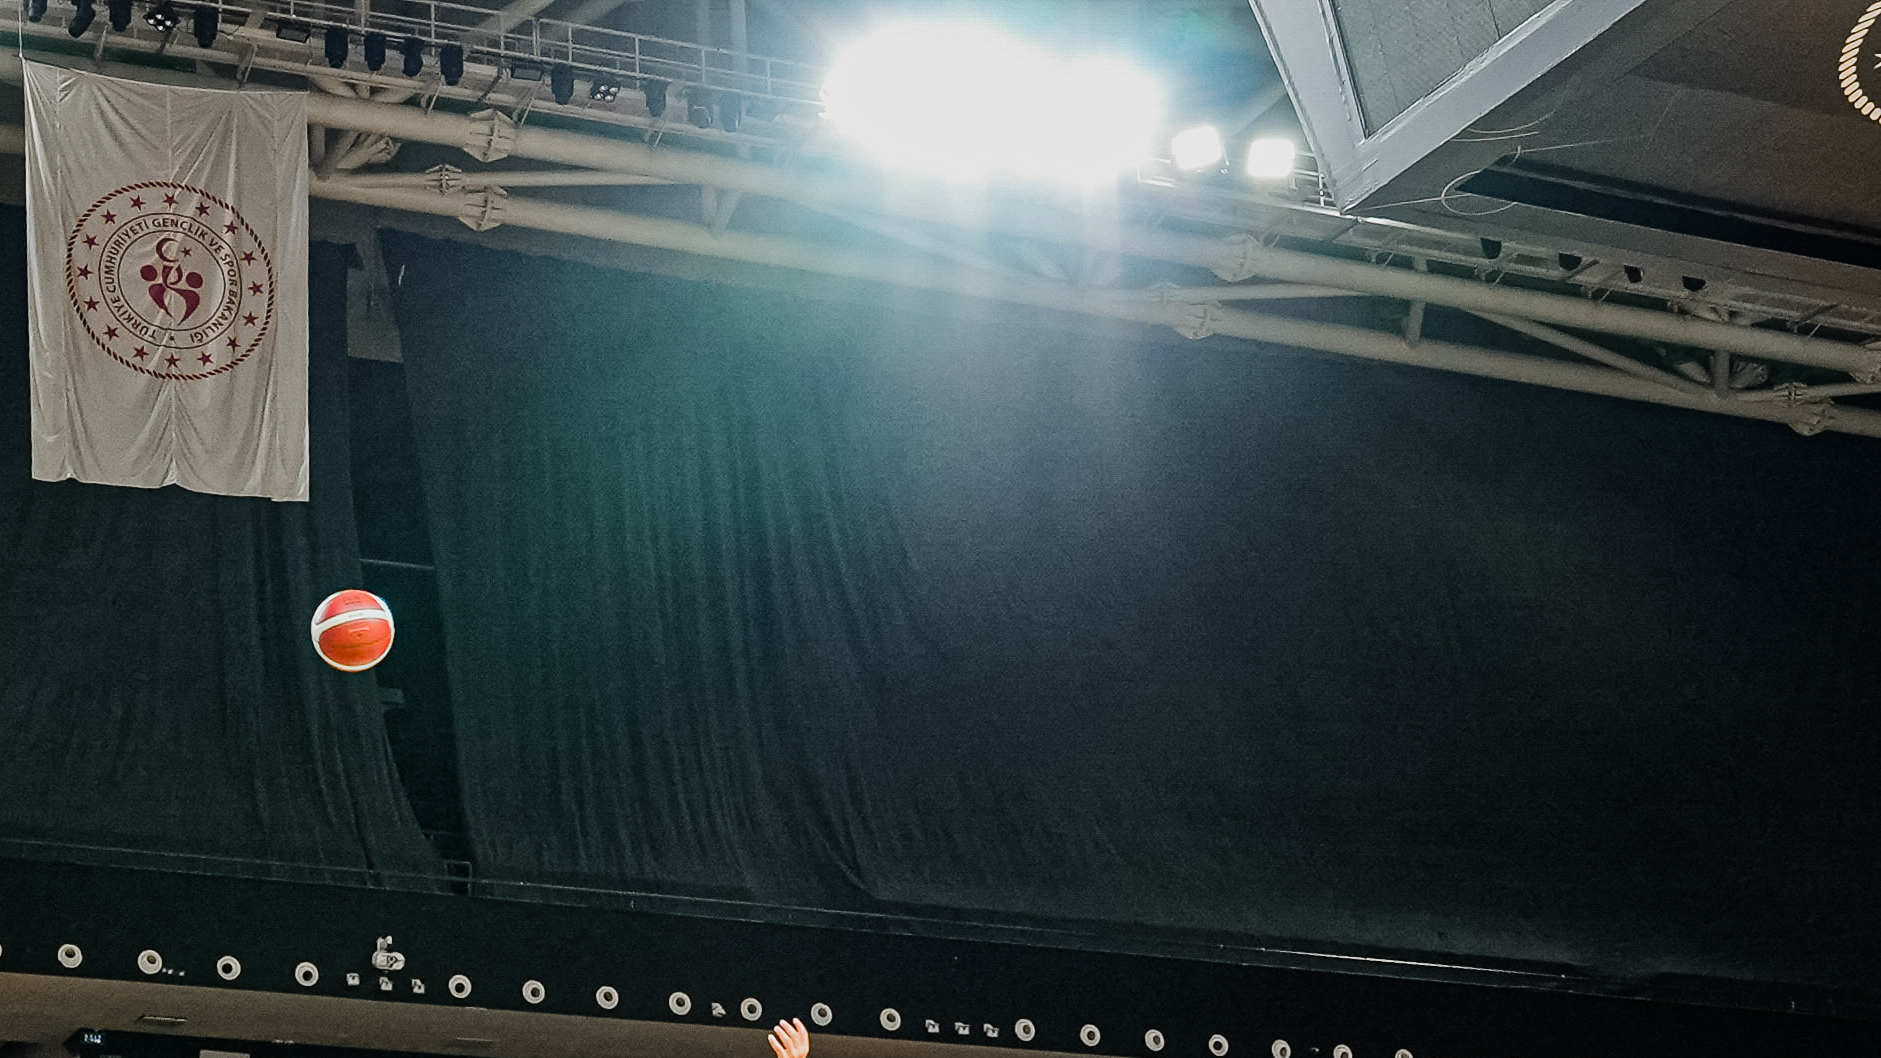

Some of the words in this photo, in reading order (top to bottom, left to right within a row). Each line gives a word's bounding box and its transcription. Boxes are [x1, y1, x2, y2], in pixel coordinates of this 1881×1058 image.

[152, 216, 207, 240] GENÇLİK
[208, 236, 223, 255] VE
[107, 218, 149, 293] CUMHURİYETİ
[218, 252, 238, 287] SPOR
[108, 294, 158, 340] TÜRKİYE
[189, 286, 239, 344] BAKANLIĞI
